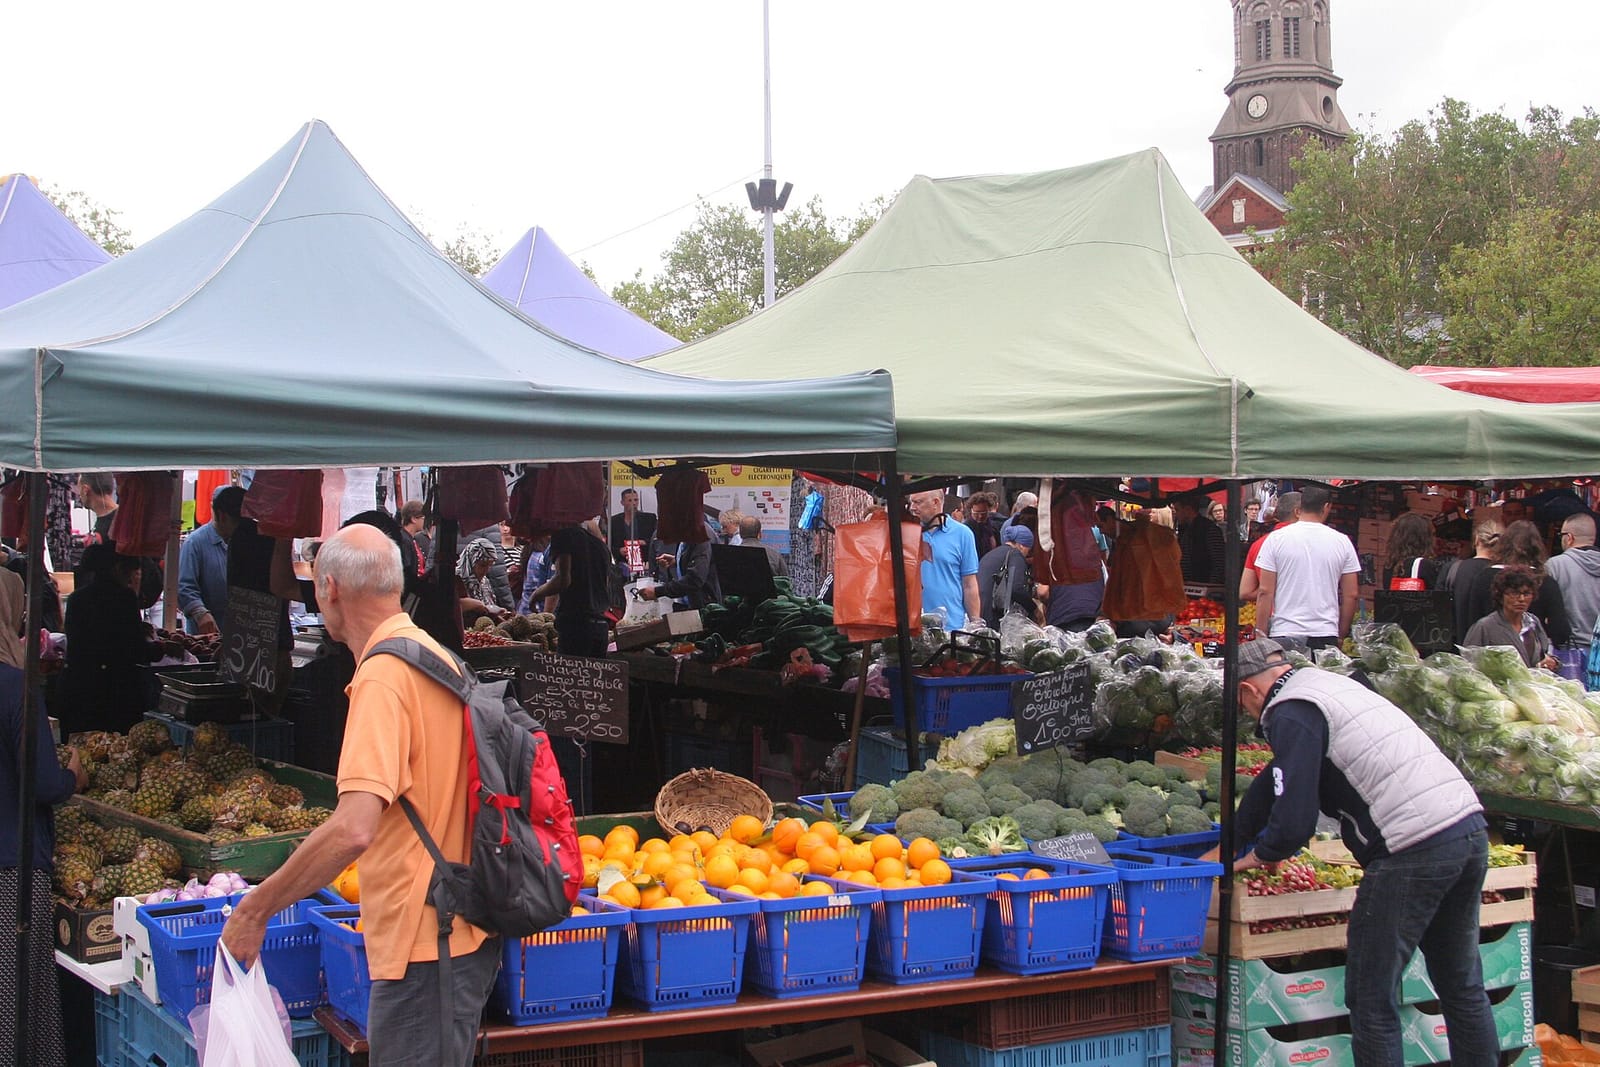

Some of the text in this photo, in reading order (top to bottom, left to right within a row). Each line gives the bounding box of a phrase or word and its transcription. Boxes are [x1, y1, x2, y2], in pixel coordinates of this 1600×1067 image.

[1272, 766, 1284, 796] 3
[1517, 927, 1529, 981] Brocoli
[1229, 964, 1240, 1024] Brocoli
[1522, 991, 1533, 1044] Brocoli
[1231, 1034, 1242, 1067] coli
